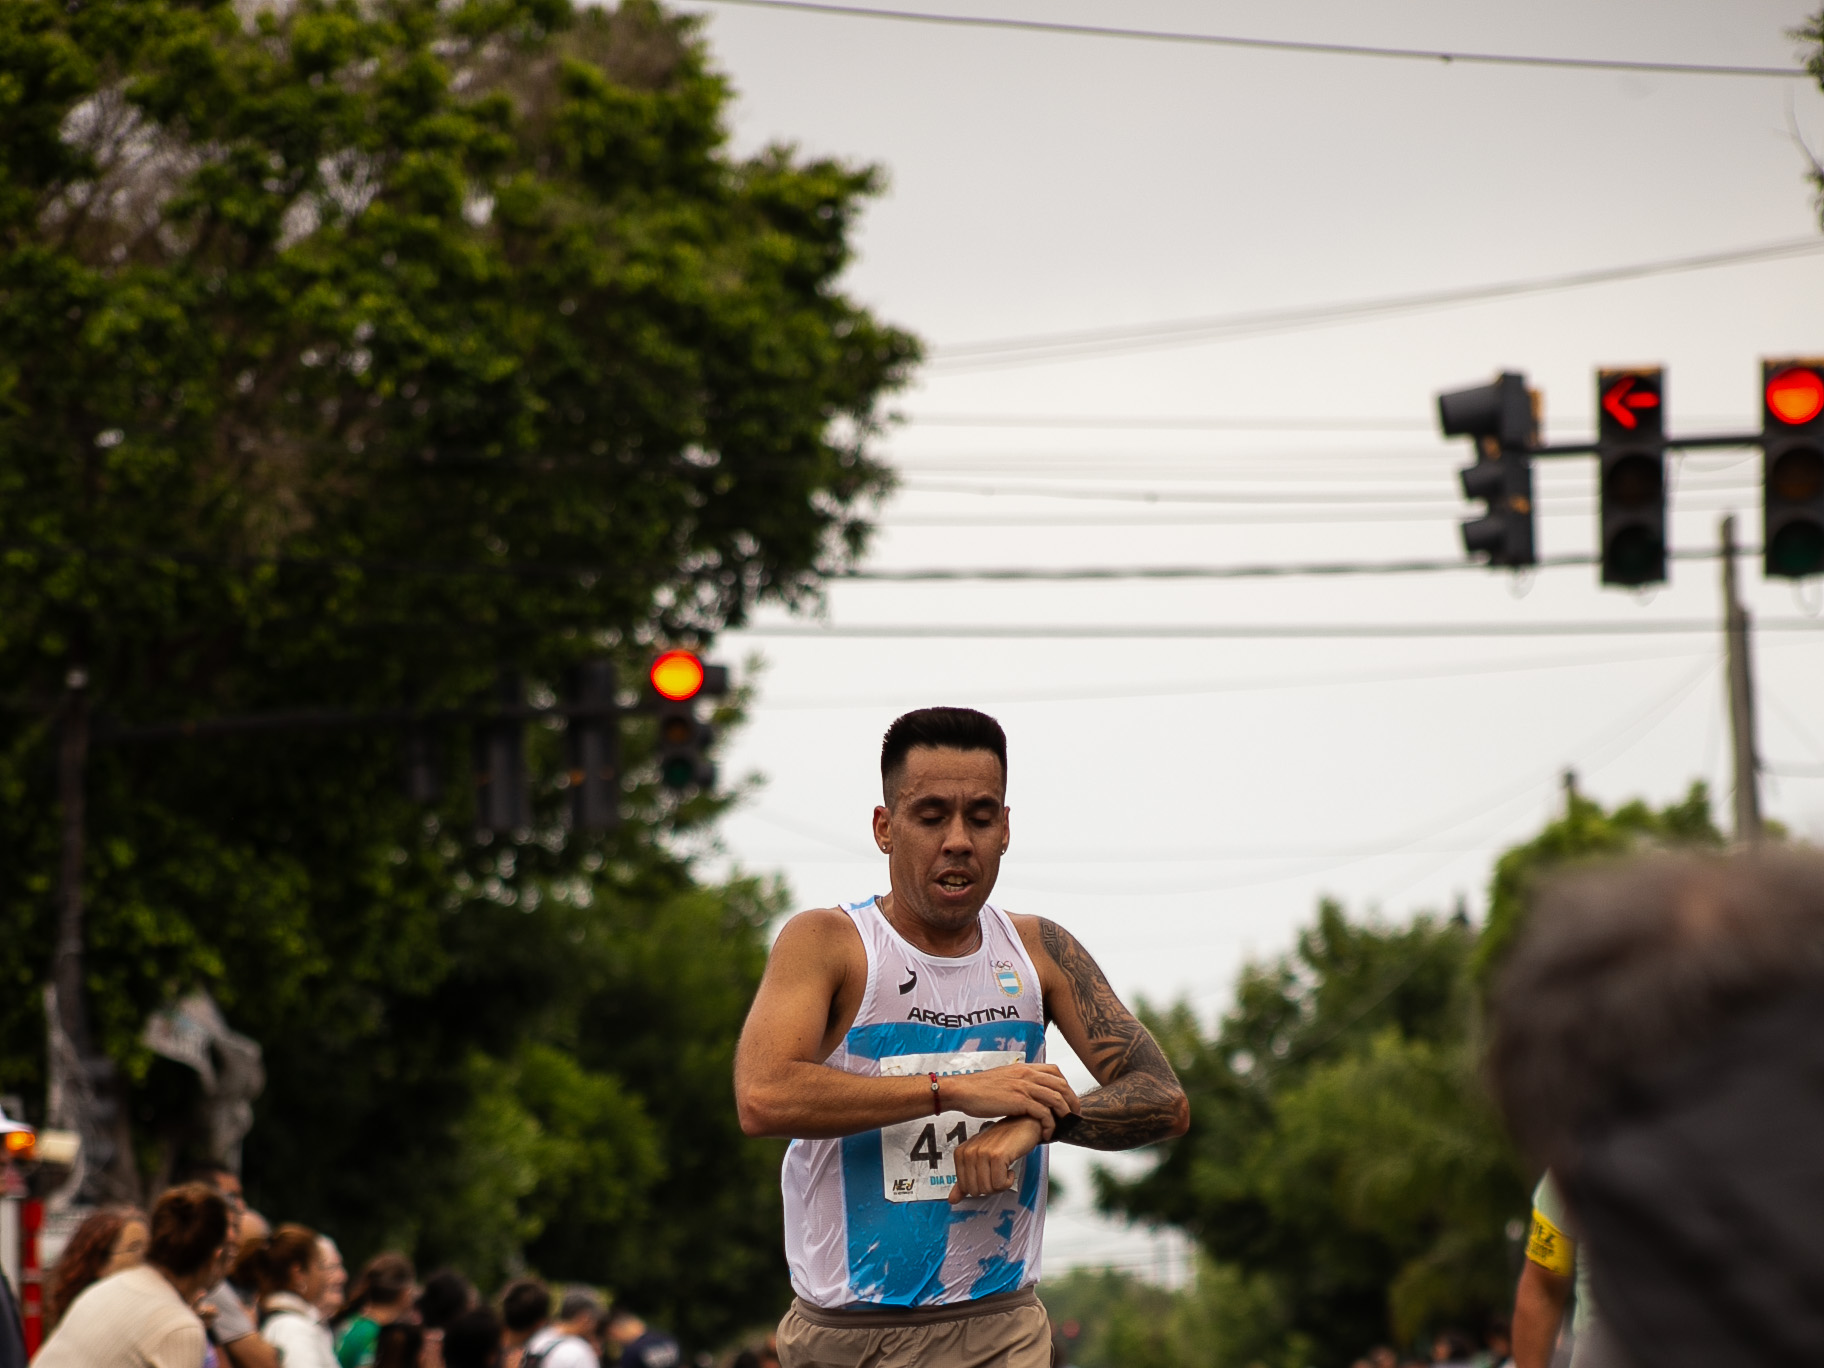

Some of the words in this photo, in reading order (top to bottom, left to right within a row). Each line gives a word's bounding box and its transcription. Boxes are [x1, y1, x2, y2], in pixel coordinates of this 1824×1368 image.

[907, 1005, 1020, 1028] ARGENTINA
[910, 1120, 996, 1170] 41
[929, 1175, 945, 1186] DIA
